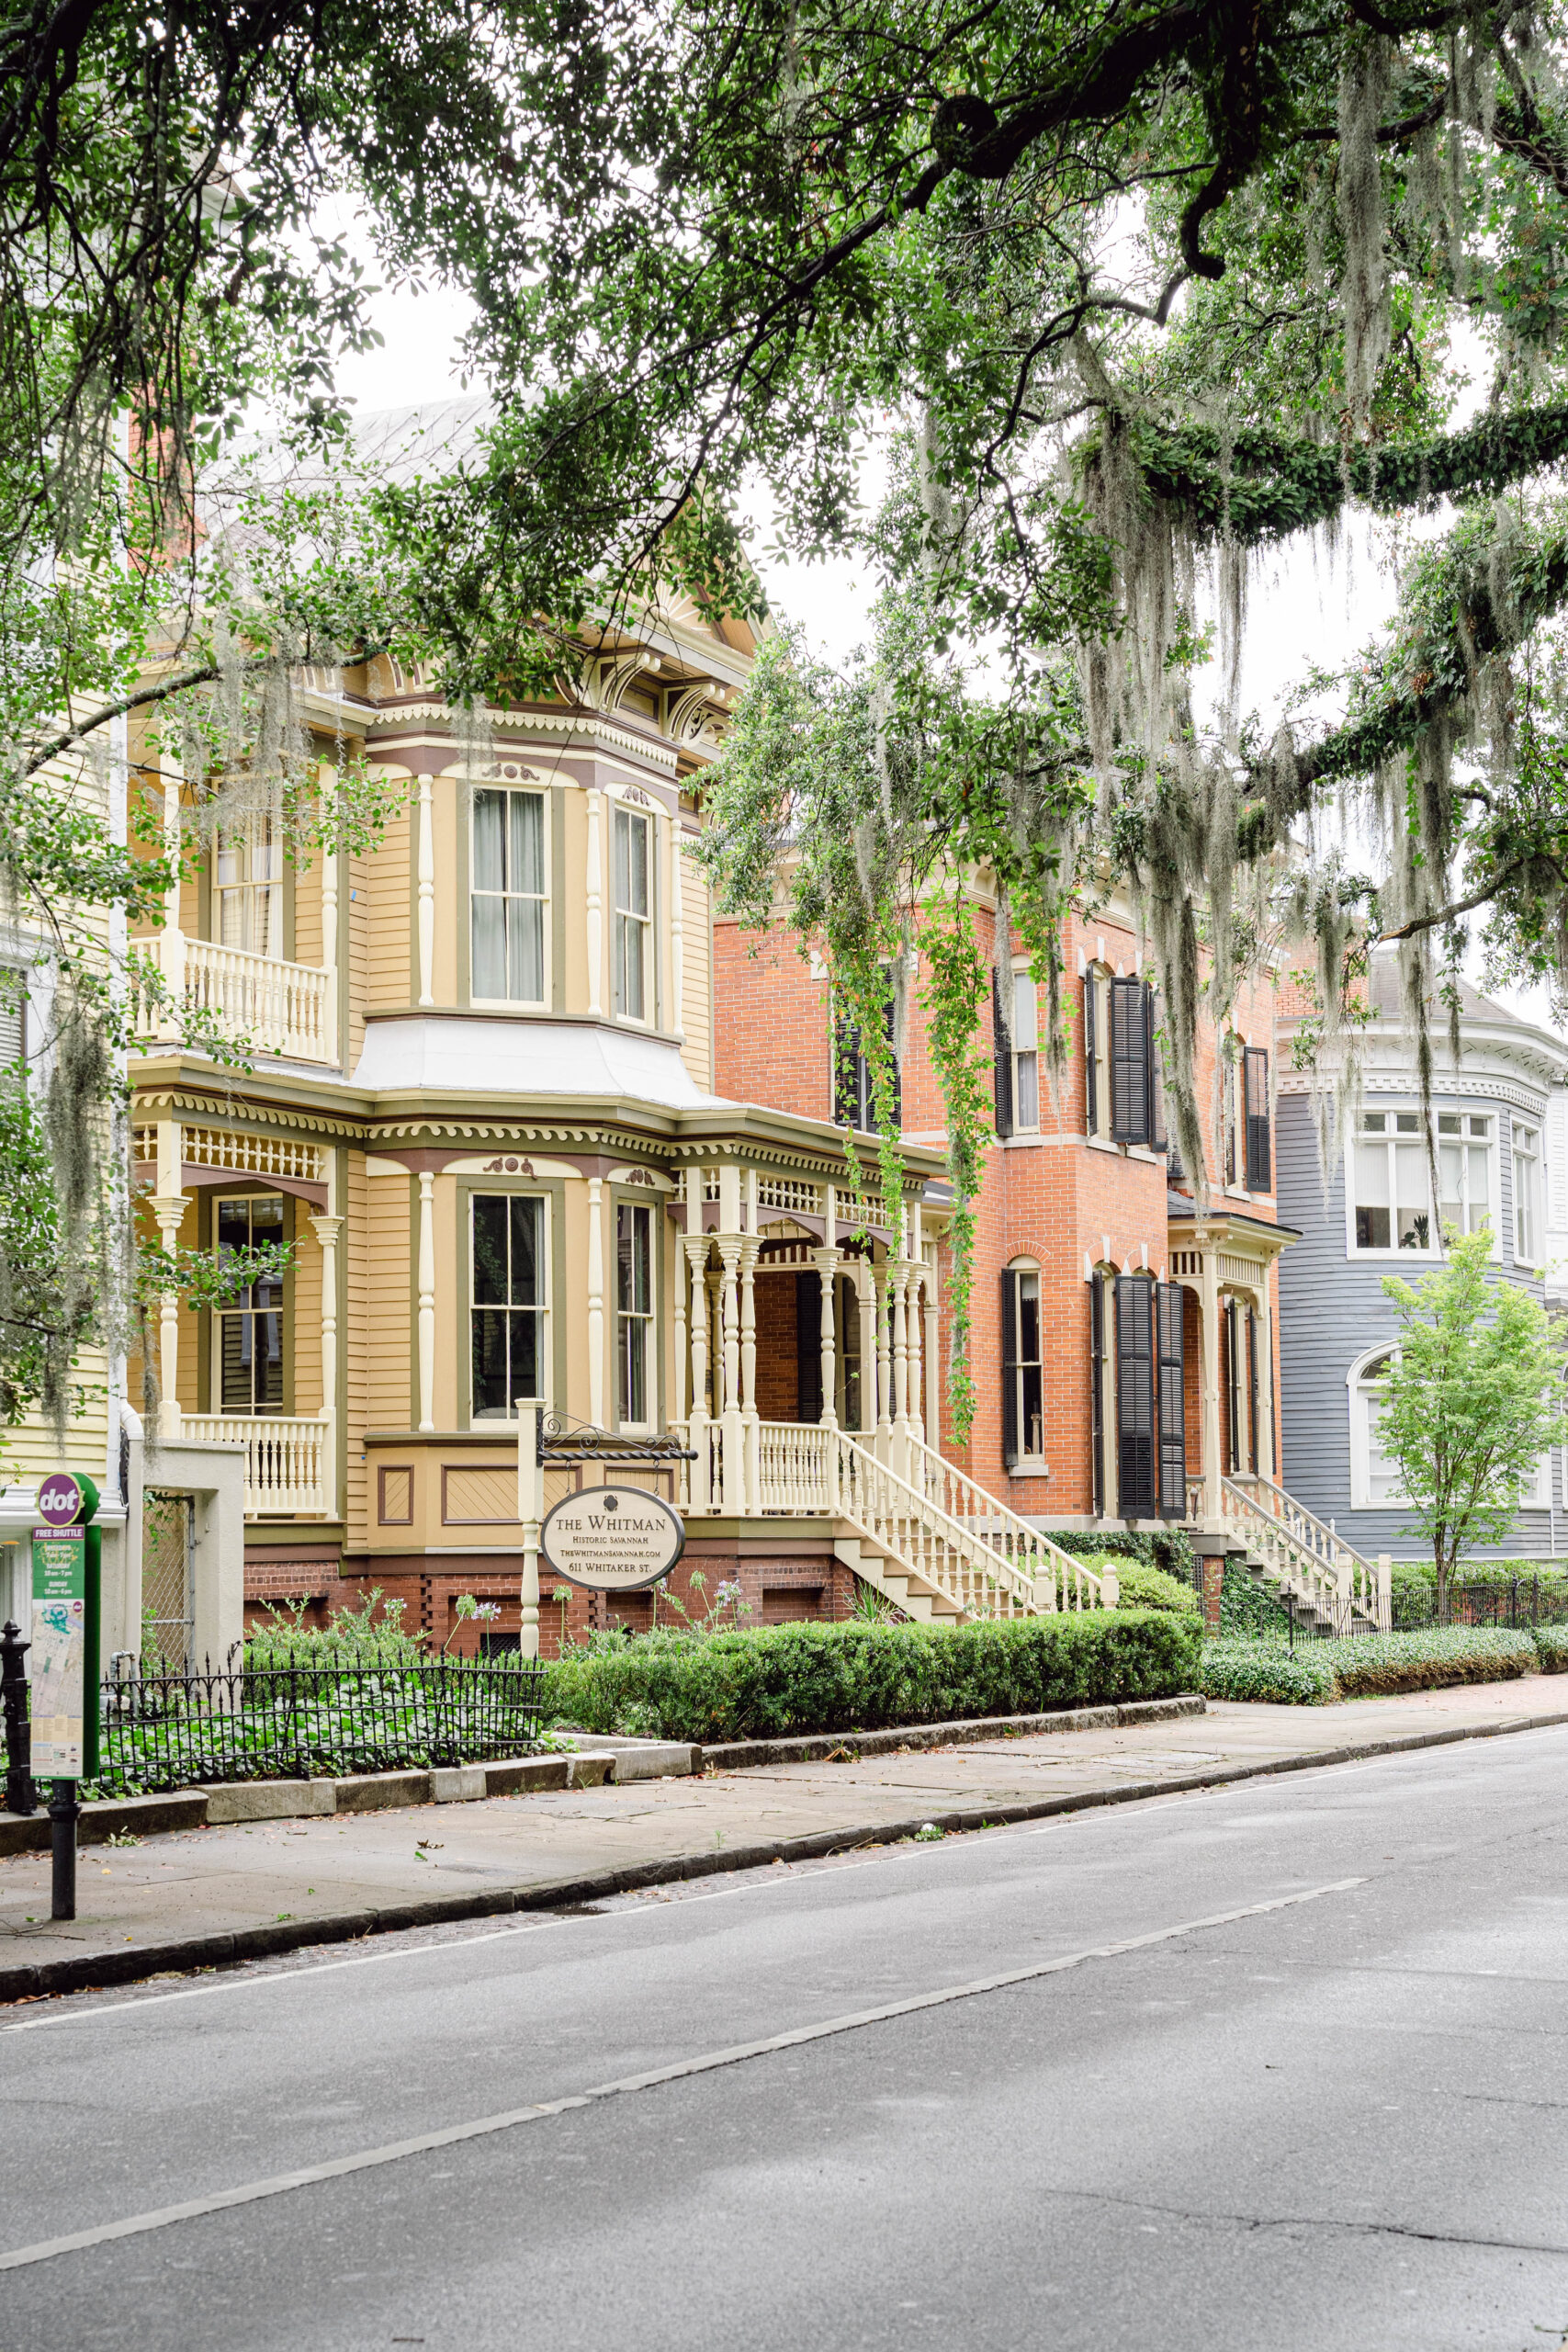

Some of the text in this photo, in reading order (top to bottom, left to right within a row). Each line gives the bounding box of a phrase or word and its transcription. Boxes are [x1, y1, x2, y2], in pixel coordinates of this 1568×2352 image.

[39, 1488, 79, 1511] dot
[556, 1515, 666, 1531] THE WHITMAN
[35, 1529, 83, 1538] FREE SHUTTLE
[572, 1536, 649, 1544] HISTORIC SAVANNAH
[569, 1563, 652, 1573] 611 WHITAKER ST.
